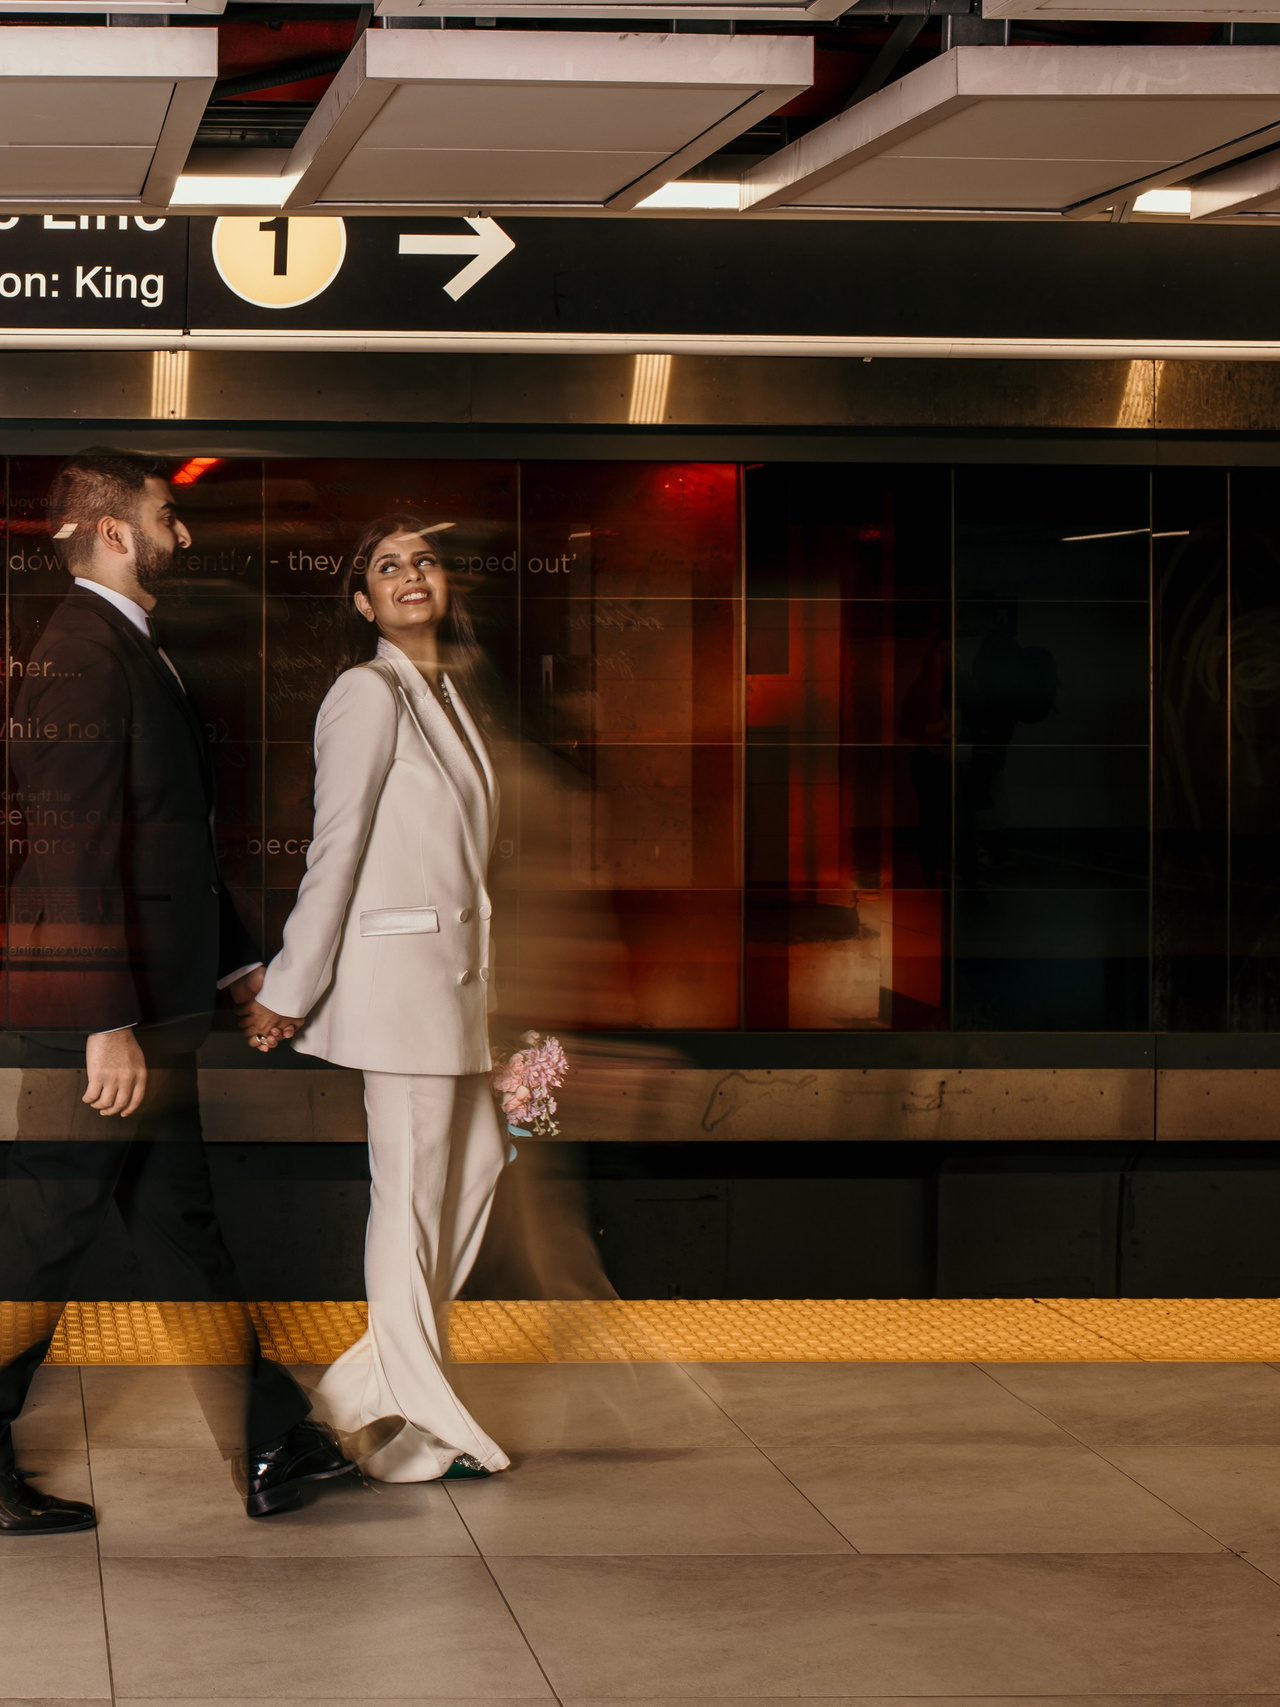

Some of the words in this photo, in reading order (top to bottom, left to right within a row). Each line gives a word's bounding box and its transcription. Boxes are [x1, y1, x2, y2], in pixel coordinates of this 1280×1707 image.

[259, 216, 289, 276] 1
[76, 265, 165, 308] King
[10, 548, 65, 570] dow
[288, 551, 344, 575] they
[9, 837, 76, 856] more
